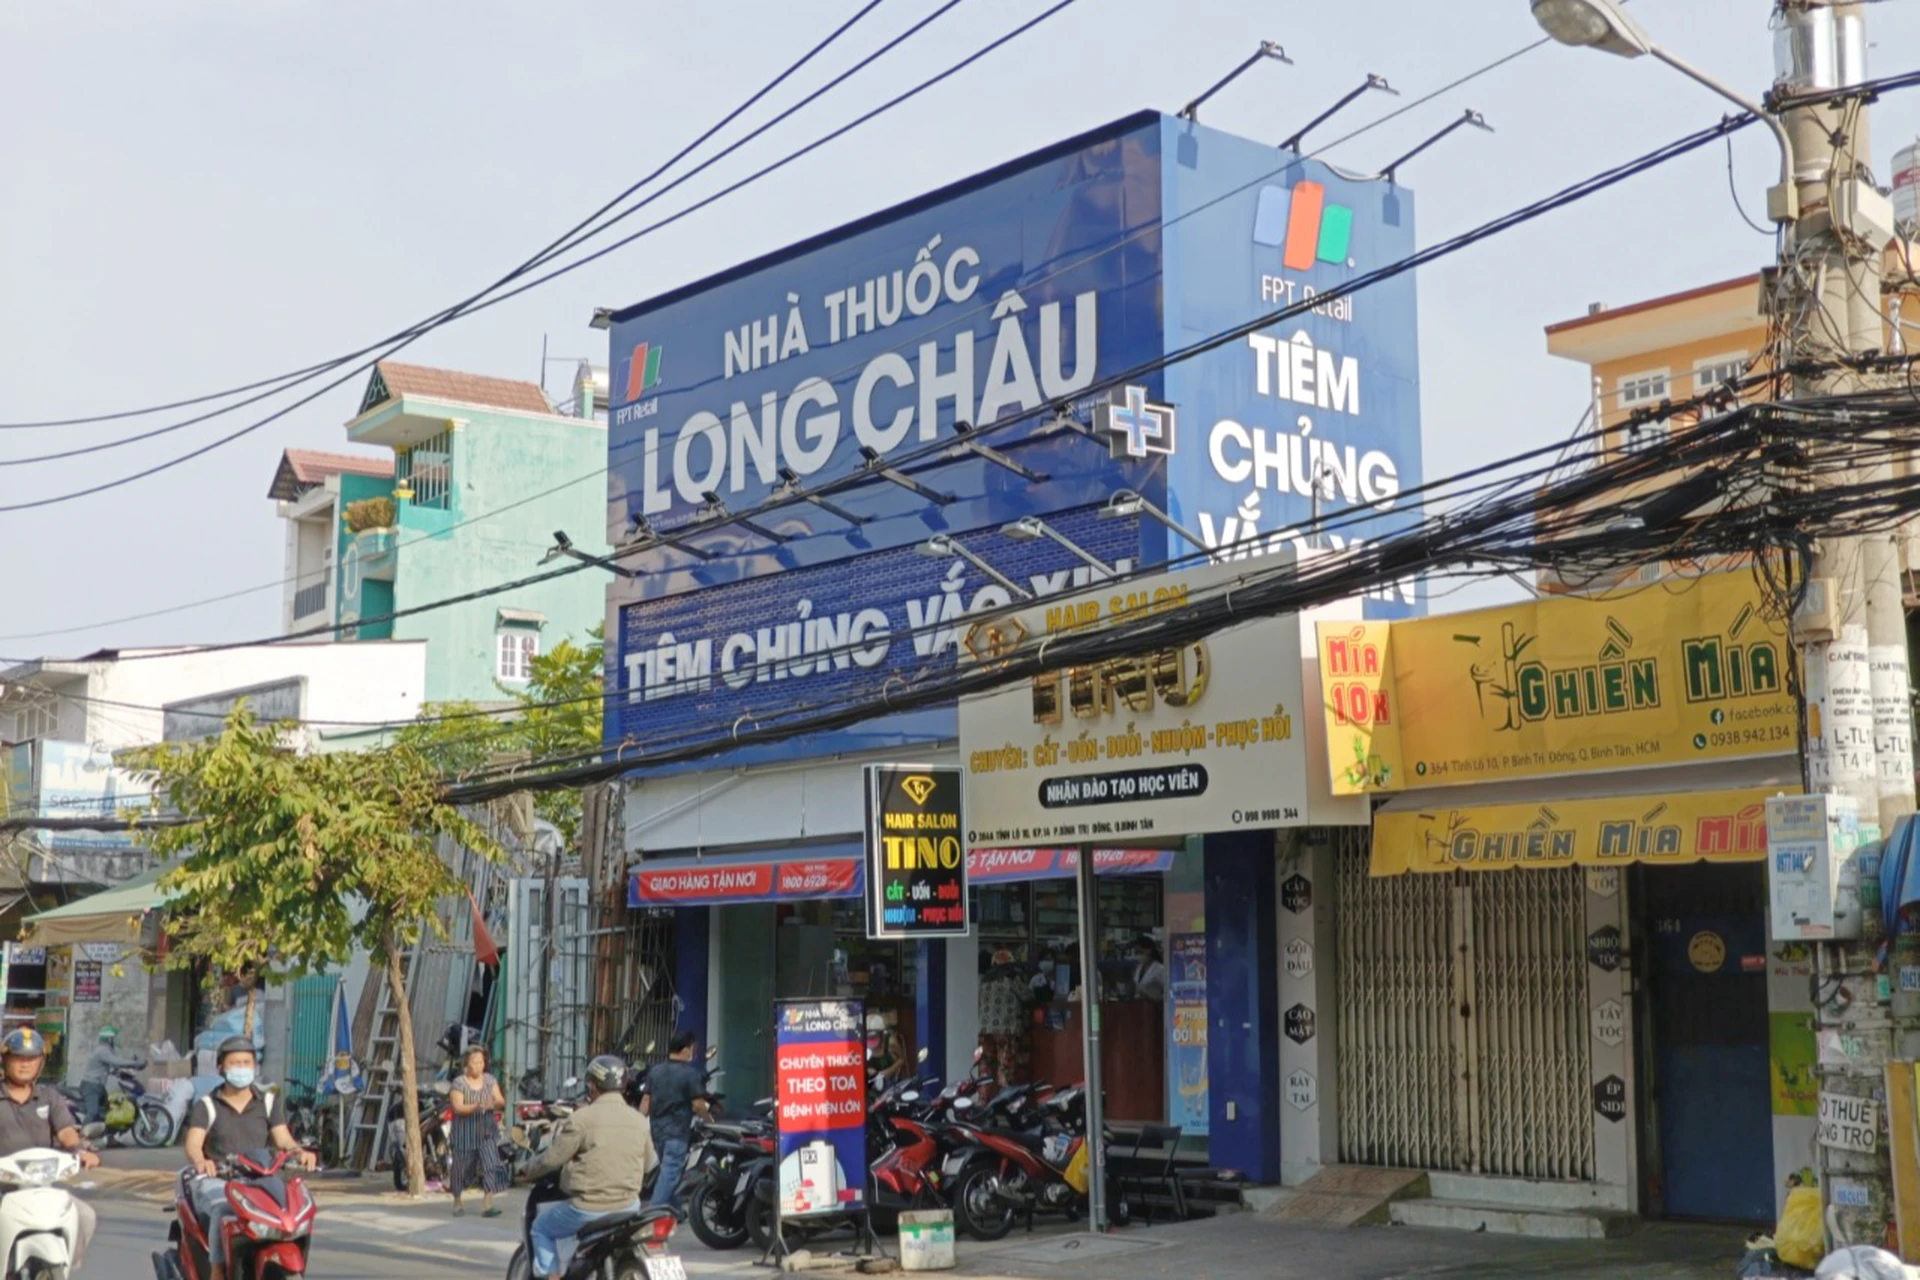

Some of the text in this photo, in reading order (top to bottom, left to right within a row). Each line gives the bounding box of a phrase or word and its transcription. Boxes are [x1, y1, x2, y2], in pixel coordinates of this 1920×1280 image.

[724, 234, 980, 378] NHÀ THUỐC
[1262, 275, 1296, 306] FPT
[1248, 330, 1359, 415] TIÊM
[616, 405, 632, 425] FPT
[643, 289, 1097, 515] LONG CHÂU
[1209, 416, 1400, 511] CHỦNG
[1046, 584, 1188, 635] HAIR SALON
[625, 632, 712, 703] TIÊM
[720, 600, 891, 690] CHỦNG
[1326, 626, 1380, 677] MÍA
[1681, 602, 1781, 704] MÍA
[970, 741, 1029, 774] CHUYÊN:
[1033, 734, 1060, 768] CẮT
[1067, 729, 1098, 765] UỐN
[1151, 718, 1207, 756] NHUỘM
[1216, 718, 1260, 751] PHỤC
[1635, 740, 1661, 755] HCM
[1047, 768, 1200, 805] NHẬN ĐÀO TẠO HỌC VIÊN
[885, 813, 958, 830] HAIR SALON
[1597, 802, 1681, 859] MÍA
[882, 836, 961, 870] TINO
[1065, 852, 1077, 865] 18
[650, 869, 757, 893] GIAO HÀNG TẬN NƠI
[782, 875, 803, 889] 1800
[804, 874, 828, 888] 6928
[885, 879, 905, 901] CẮT
[912, 881, 931, 901] UỐN
[805, 1020, 831, 1032] LONG
[780, 1050, 862, 1070] CHUYÊN THUỐC
[787, 1074, 857, 1095] THEO TOA
[783, 1099, 861, 1121] BỆNH VIỆN LỚN
[1831, 1098, 1871, 1124] THUÊ
